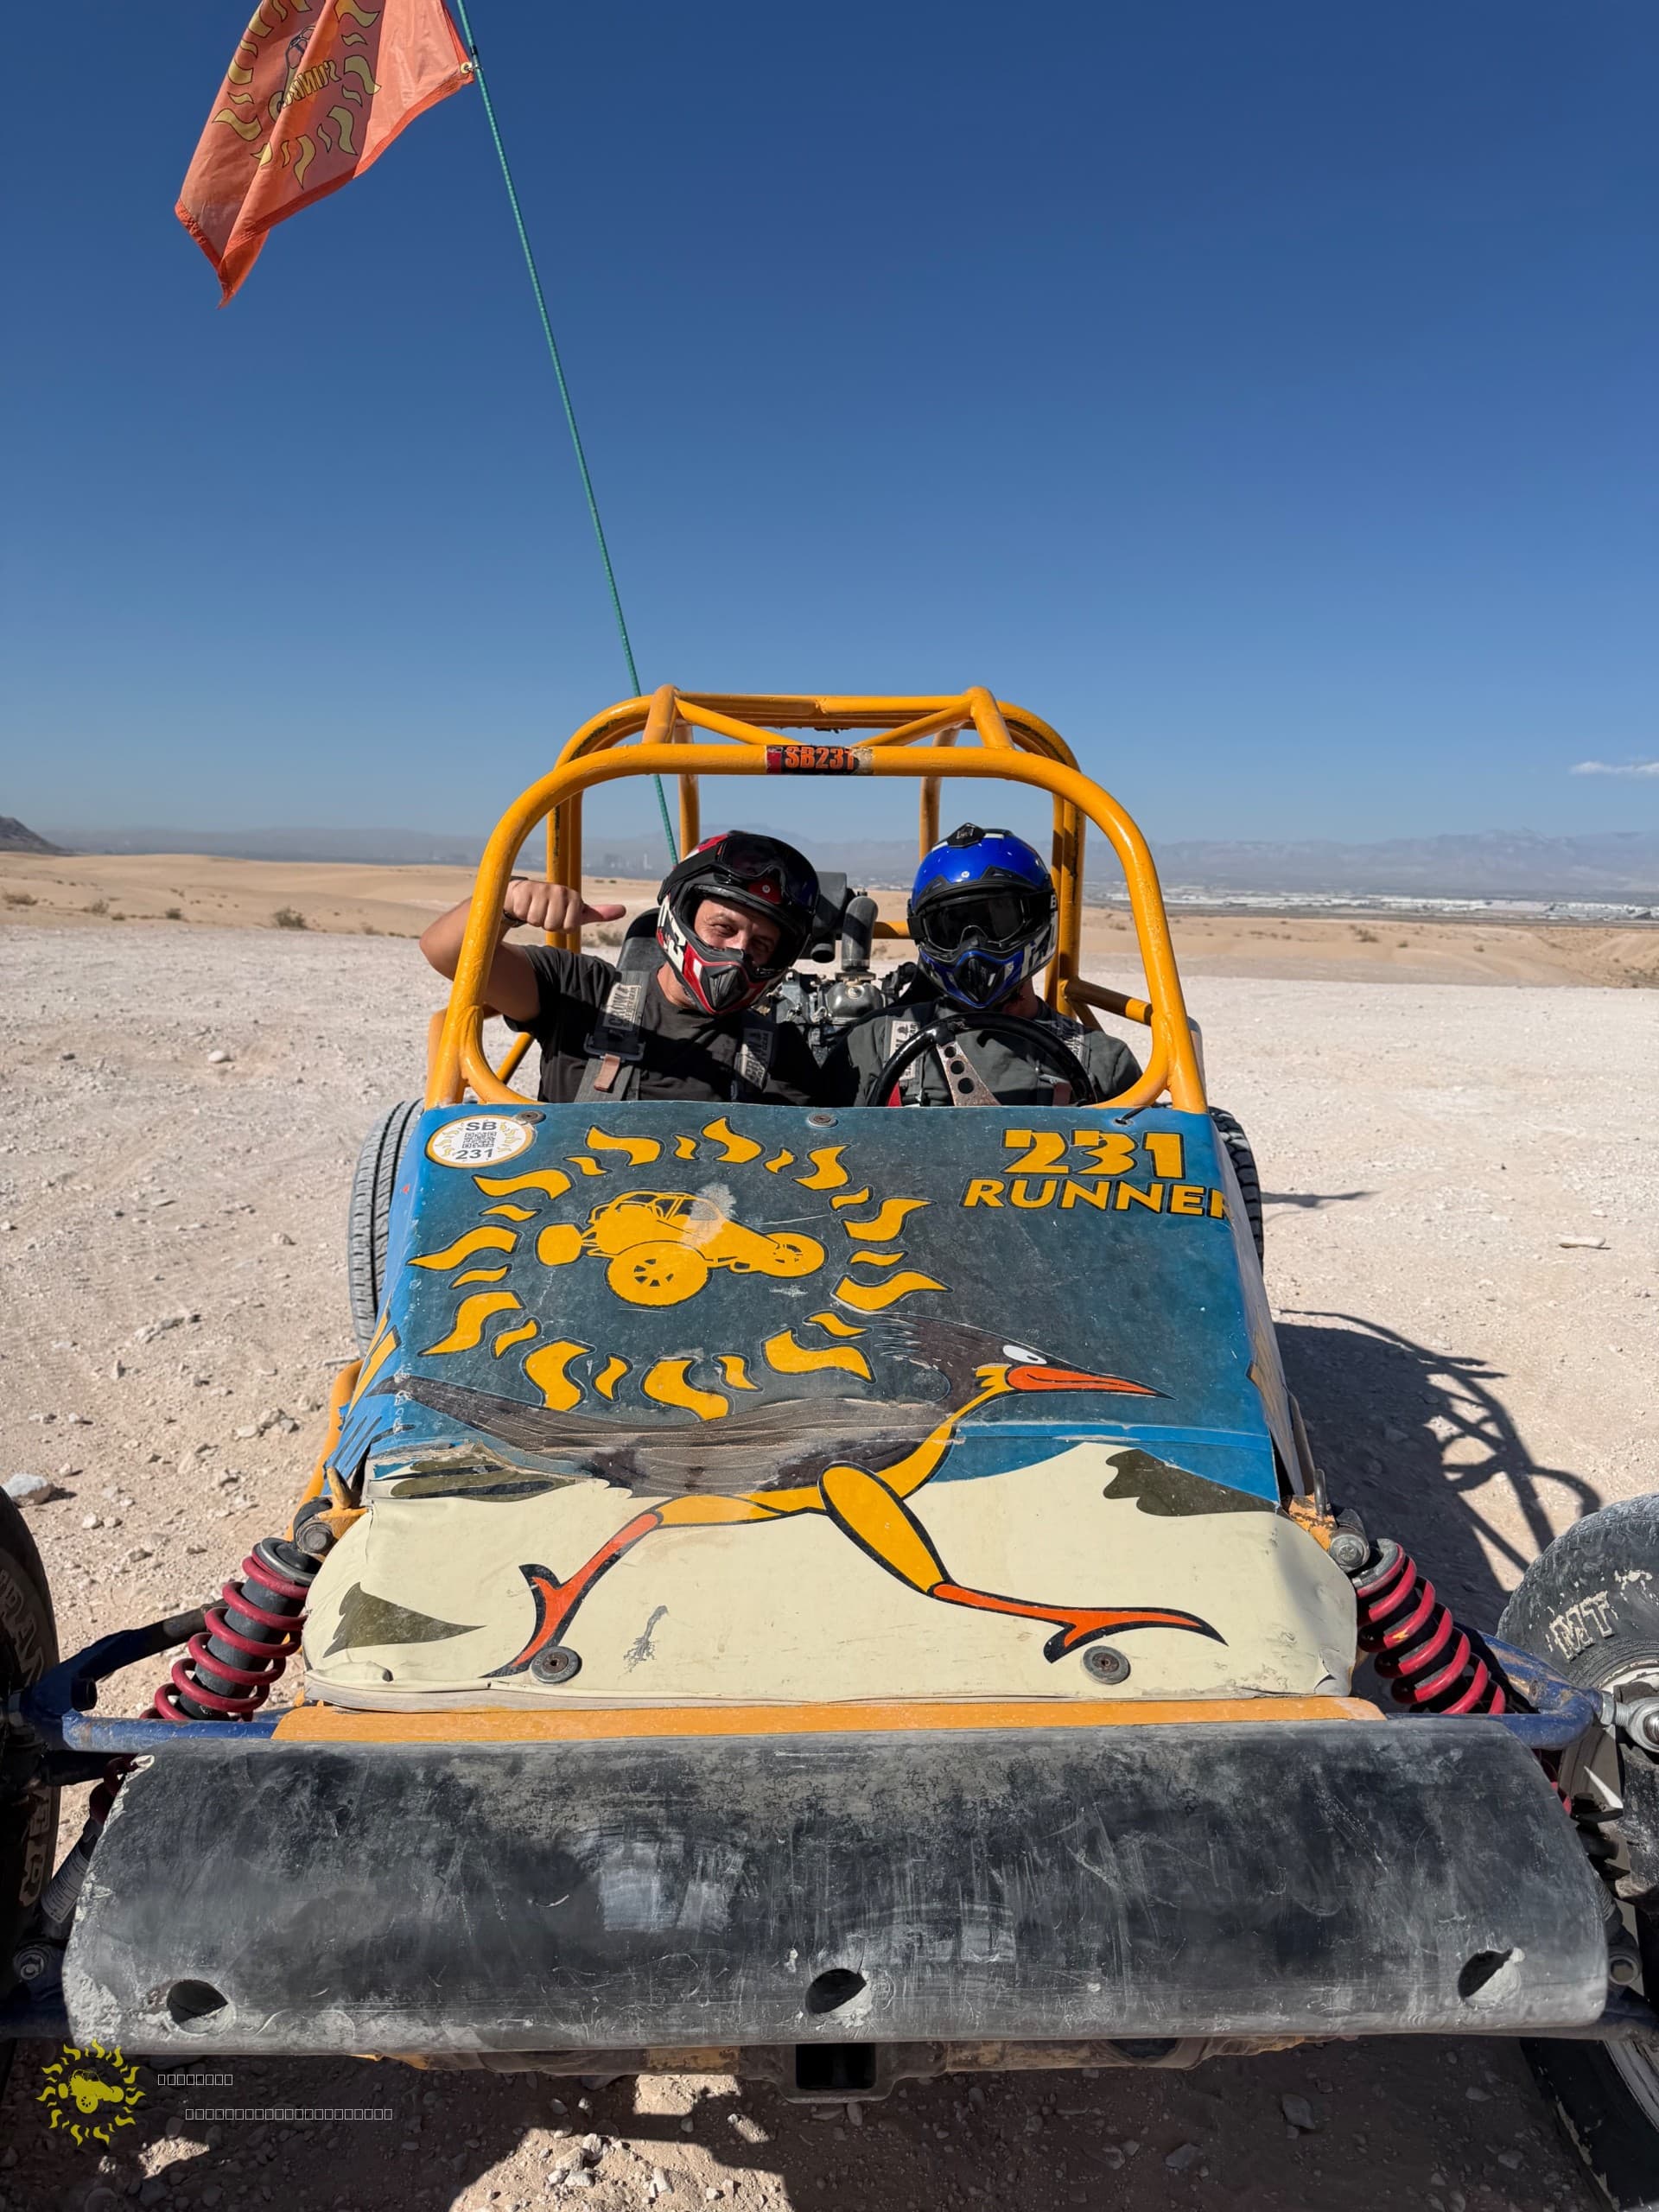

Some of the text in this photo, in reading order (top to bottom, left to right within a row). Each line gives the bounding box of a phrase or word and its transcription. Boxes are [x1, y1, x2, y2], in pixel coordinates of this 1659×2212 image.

[785, 746, 855, 770] SB231
[466, 1122, 497, 1131] SB
[455, 1149, 493, 1160] 231
[1002, 1128, 1186, 1179] 231
